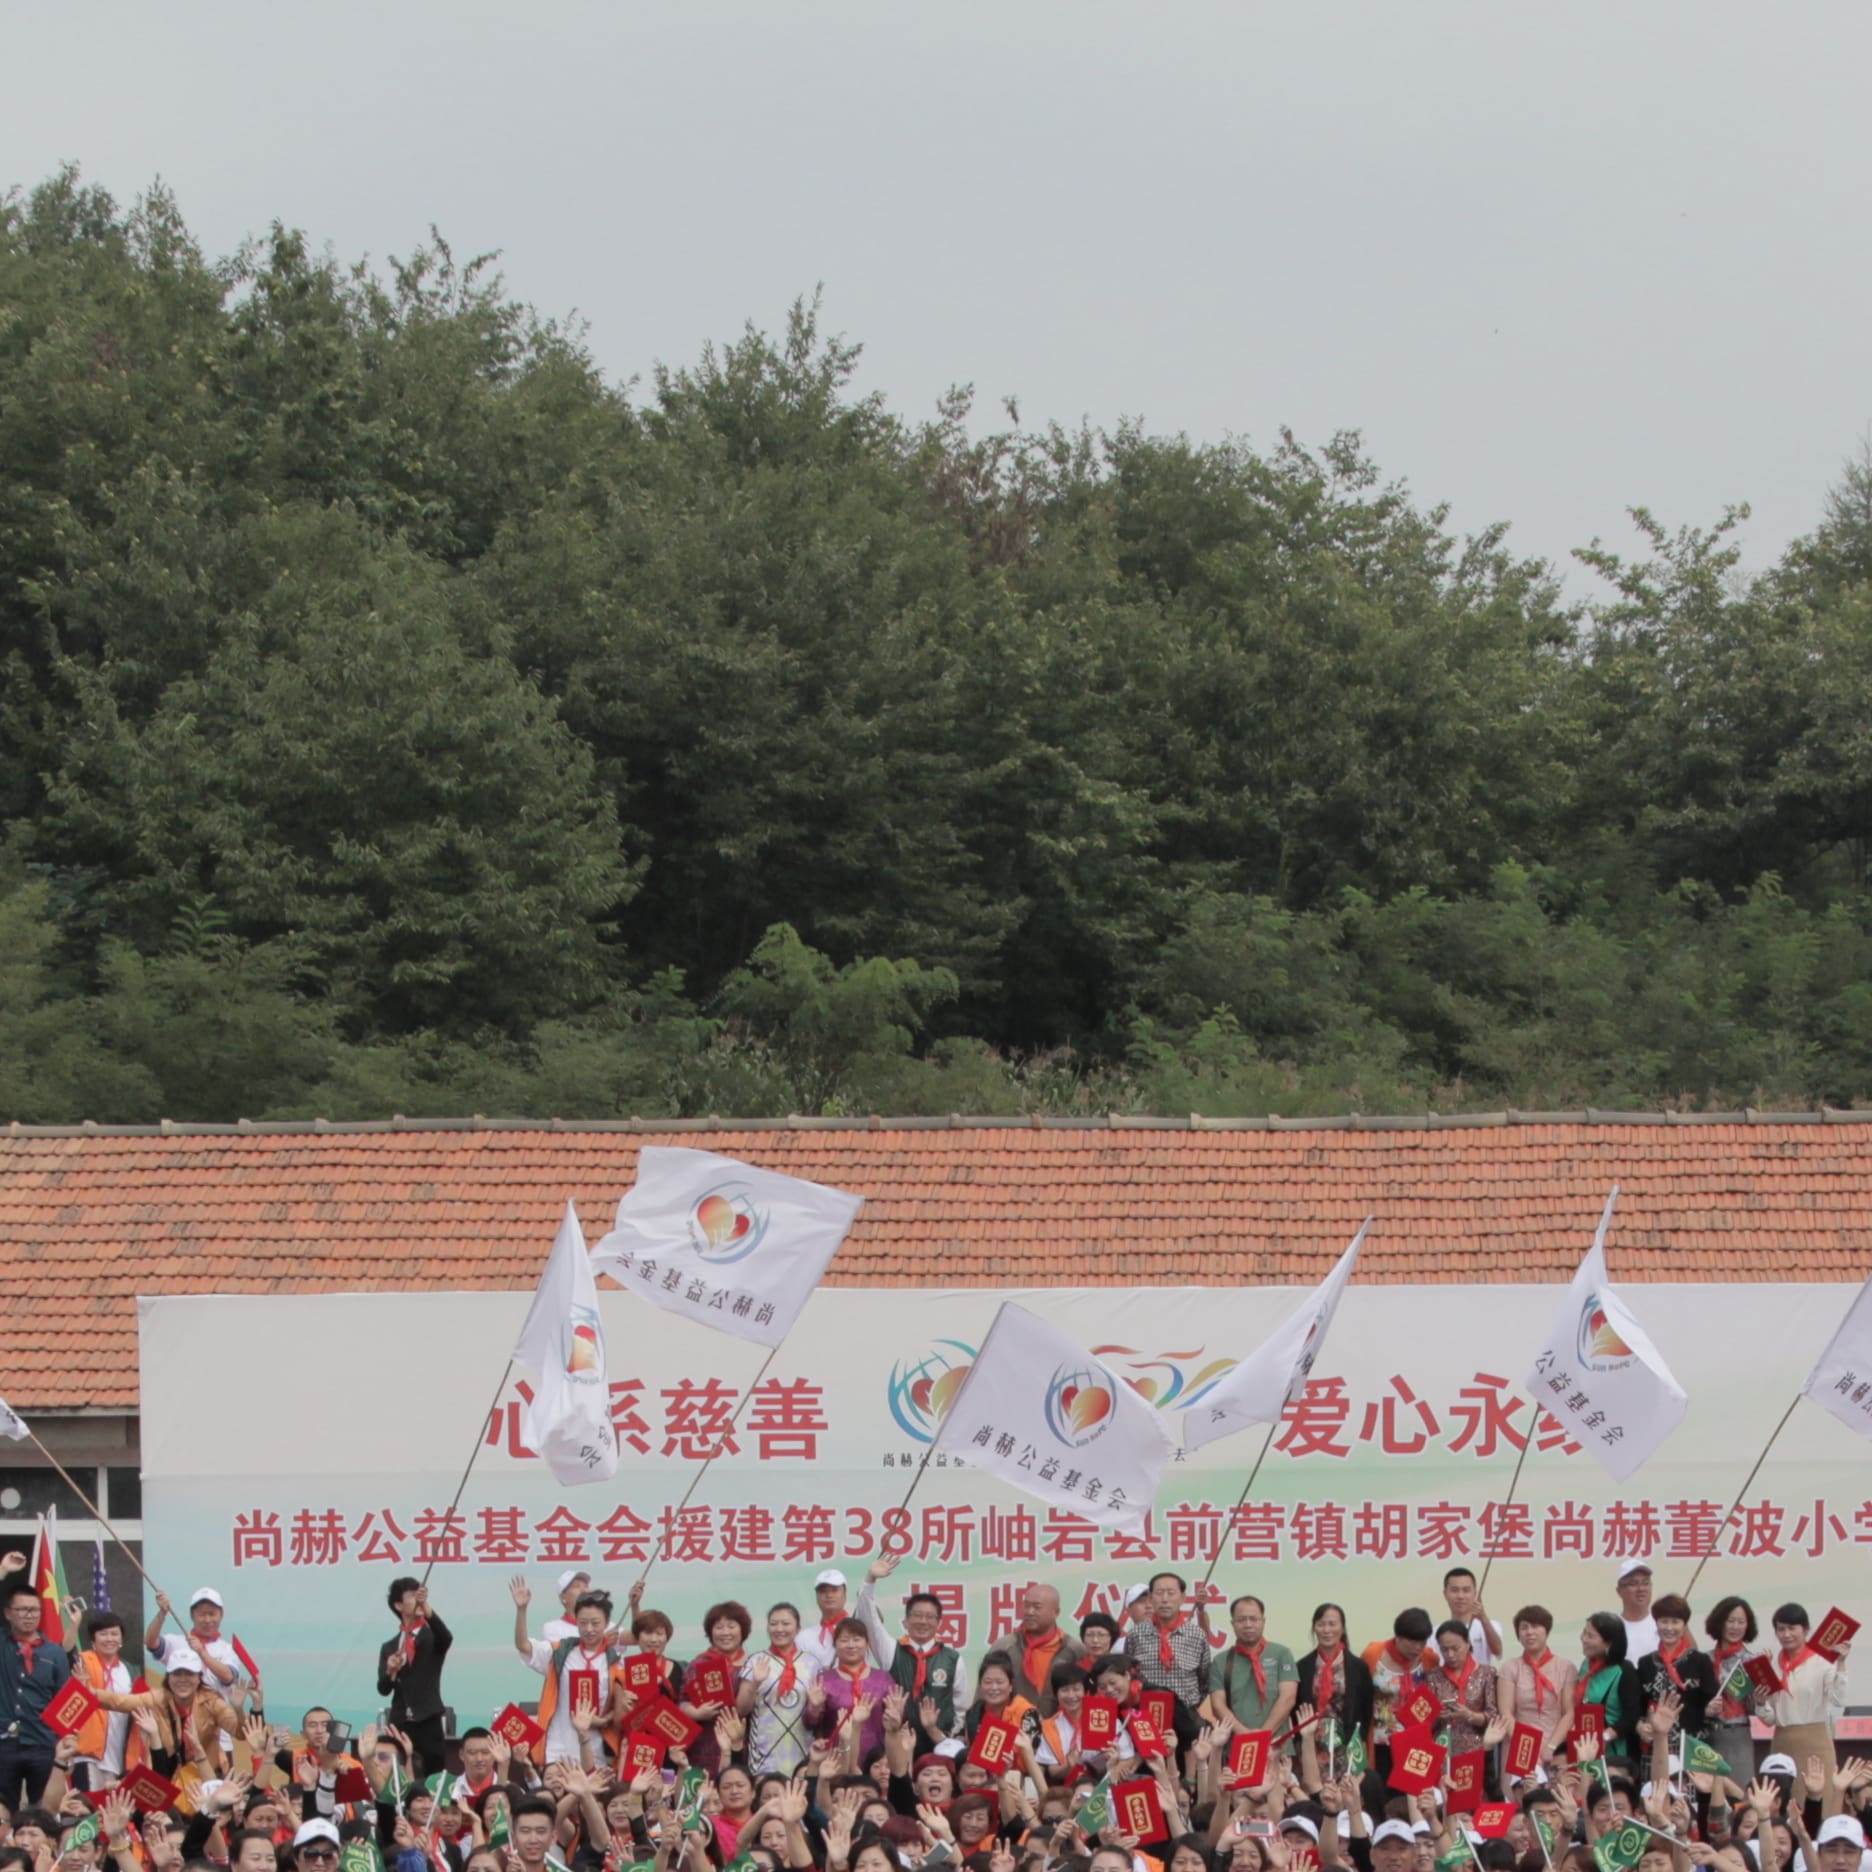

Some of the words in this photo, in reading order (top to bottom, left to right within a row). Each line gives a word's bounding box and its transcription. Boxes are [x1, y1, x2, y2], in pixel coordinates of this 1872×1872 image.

[971, 1423, 1127, 1512] 尚赫公益基金会
